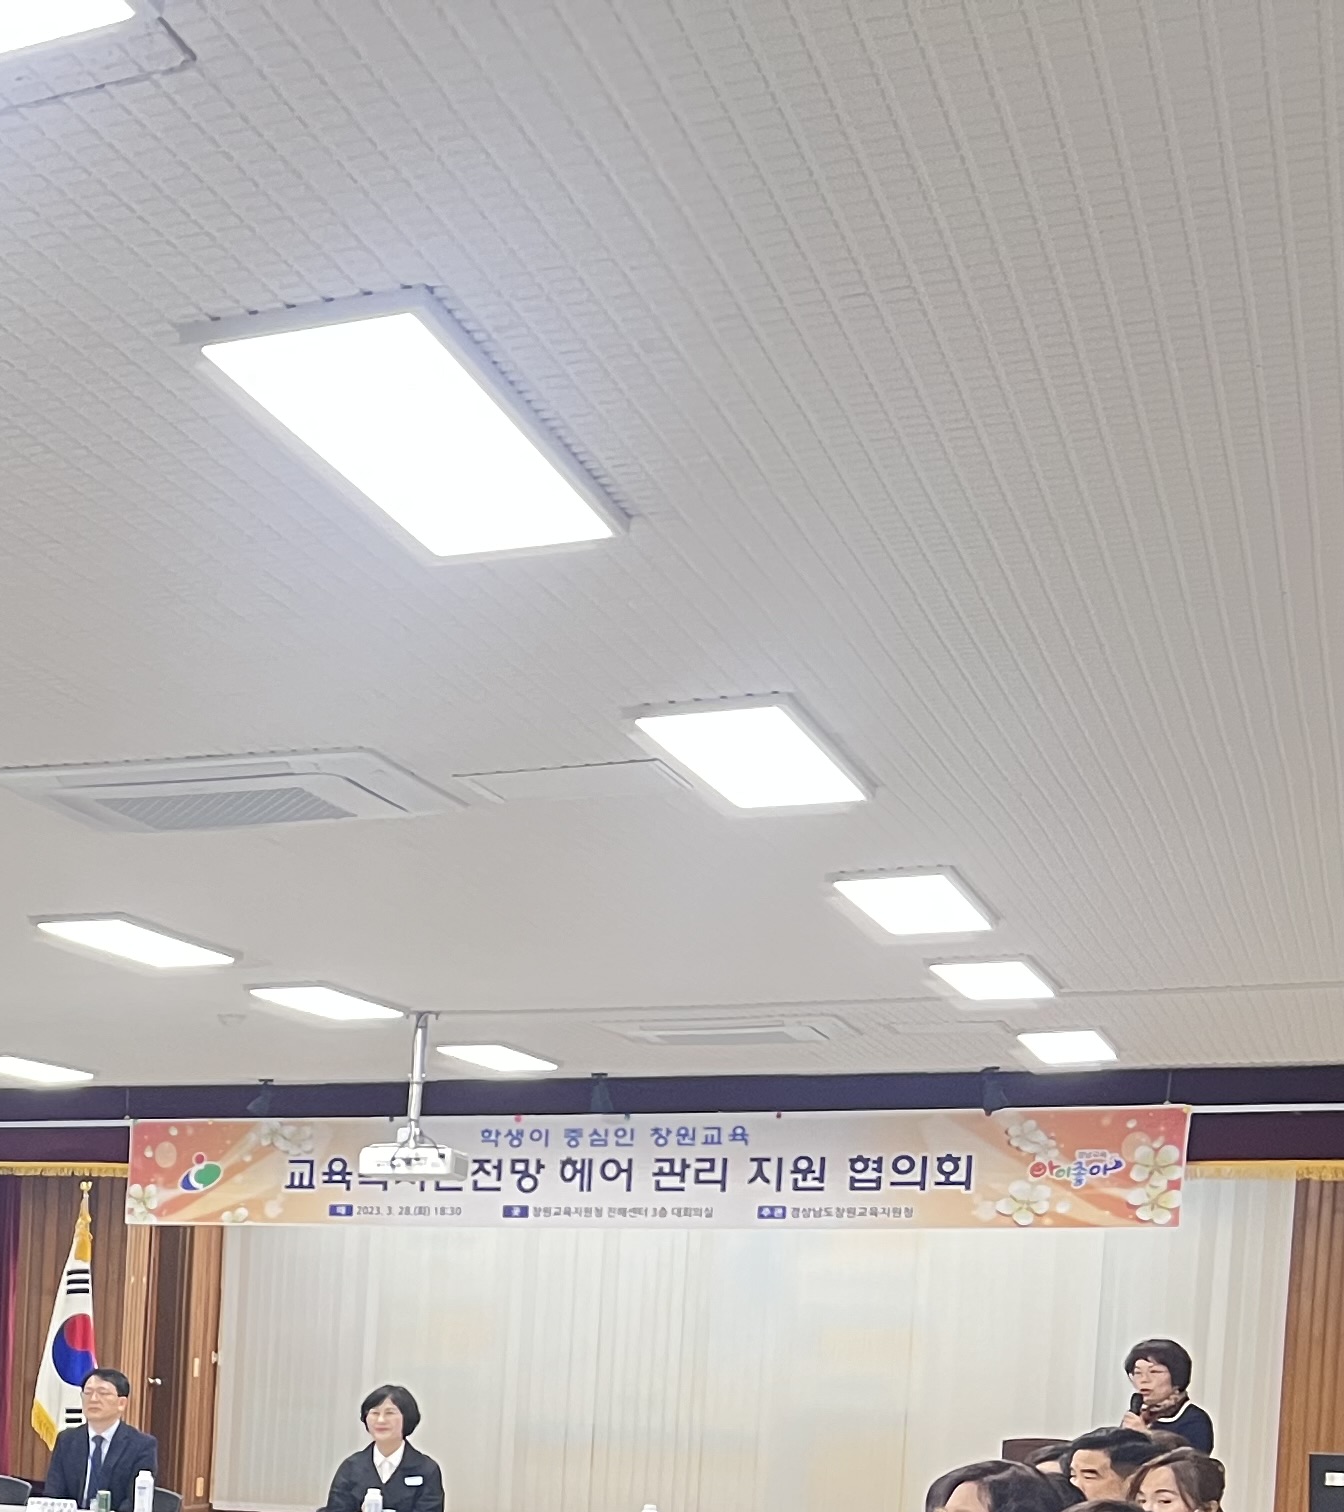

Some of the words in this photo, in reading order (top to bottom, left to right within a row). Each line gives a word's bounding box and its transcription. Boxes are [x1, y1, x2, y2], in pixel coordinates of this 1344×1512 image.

[480, 1127, 550, 1147] 학생이
[563, 1127, 635, 1147] 중심인
[649, 1125, 750, 1147] 창원교육
[284, 1157, 546, 1194] 교육전망
[558, 1156, 635, 1193] 헤어
[651, 1156, 729, 1193] 관리
[747, 1156, 827, 1193] 지원
[848, 1153, 974, 1193] 협의회
[1029, 1160, 1123, 1187] 아이좋아
[434, 1206, 462, 1217] 18:30
